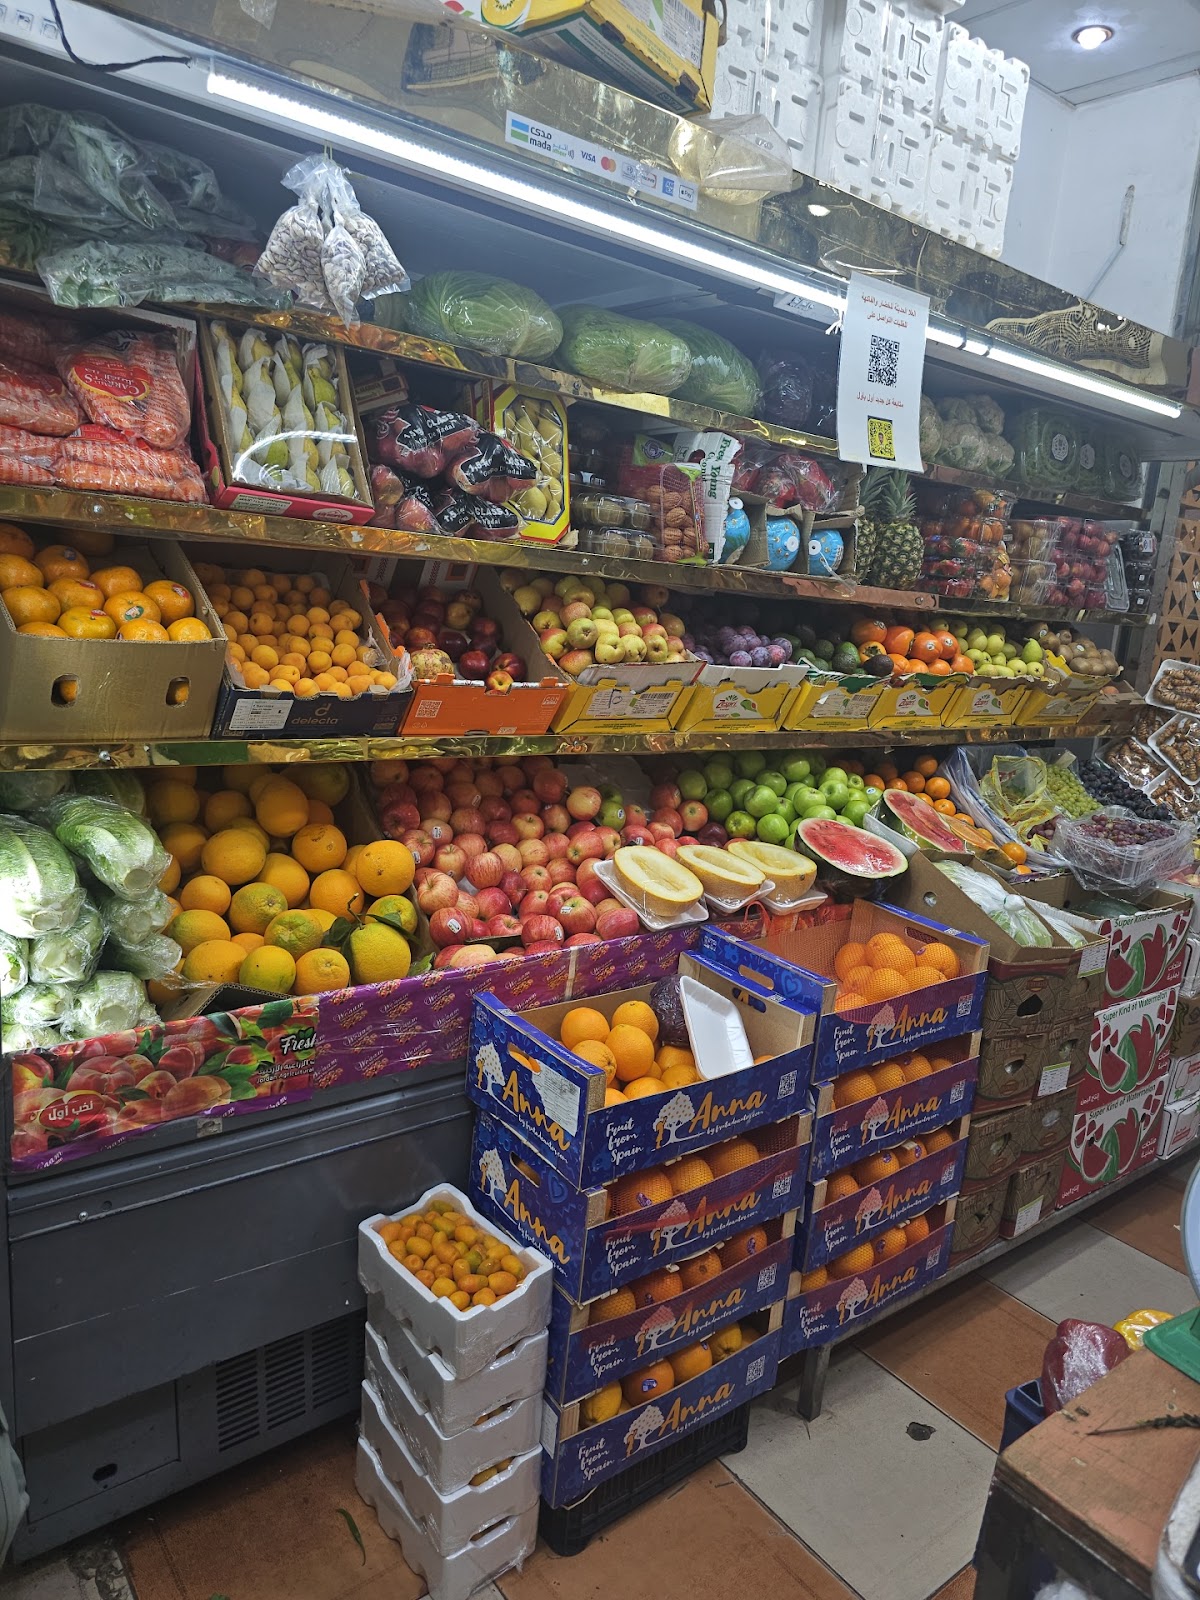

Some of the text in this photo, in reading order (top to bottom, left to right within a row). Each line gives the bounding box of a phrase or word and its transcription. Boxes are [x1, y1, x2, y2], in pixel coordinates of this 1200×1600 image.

[529, 138, 551, 151] mada
[580, 151, 596, 163] VISA
[426, 412, 455, 429] CLASS
[717, 437, 731, 460] Fres
[475, 507, 502, 516] CLASS
[291, 717, 338, 725] delecta
[1114, 917, 1133, 928] Super
[1102, 991, 1168, 1023] Super Kind of Watermelon
[834, 1024, 855, 1039] Fruit
[889, 1004, 948, 1040] Anna
[835, 1037, 856, 1050] from
[836, 1049, 859, 1064] Spain
[256, 1075, 278, 1084] Jordan
[48, 1101, 94, 1121] نخب أول
[502, 1070, 570, 1150] Anna
[689, 1090, 767, 1133] Anna
[1089, 1084, 1156, 1120] Super Kind of Watermelon
[884, 1096, 942, 1132] Anna
[606, 1117, 635, 1137] Fruit
[829, 1121, 849, 1137] Fruit
[608, 1133, 639, 1150] from
[830, 1133, 850, 1148] from
[611, 1145, 644, 1165] Spain
[831, 1144, 854, 1161] Spain
[878, 1179, 933, 1220] Anna
[504, 1179, 570, 1264] Anna
[685, 1191, 761, 1238] Anna
[824, 1214, 843, 1231] Fruit
[605, 1230, 633, 1250] Fruit
[825, 1225, 845, 1242] from
[607, 1245, 636, 1263] from
[826, 1235, 848, 1253] Spain
[609, 1256, 642, 1277] Spain
[863, 1266, 918, 1309] Anna
[669, 1287, 746, 1338] Anna
[800, 1301, 822, 1319] Fruit
[801, 1313, 825, 1329] from
[802, 1324, 830, 1339] Spain
[588, 1335, 617, 1355] Fruit
[590, 1347, 620, 1366] from
[592, 1357, 625, 1378] Spain
[658, 1382, 736, 1437] Anna
[578, 1438, 606, 1459] Fruit
[580, 1449, 609, 1470] from
[582, 1459, 615, 1481] Spain
